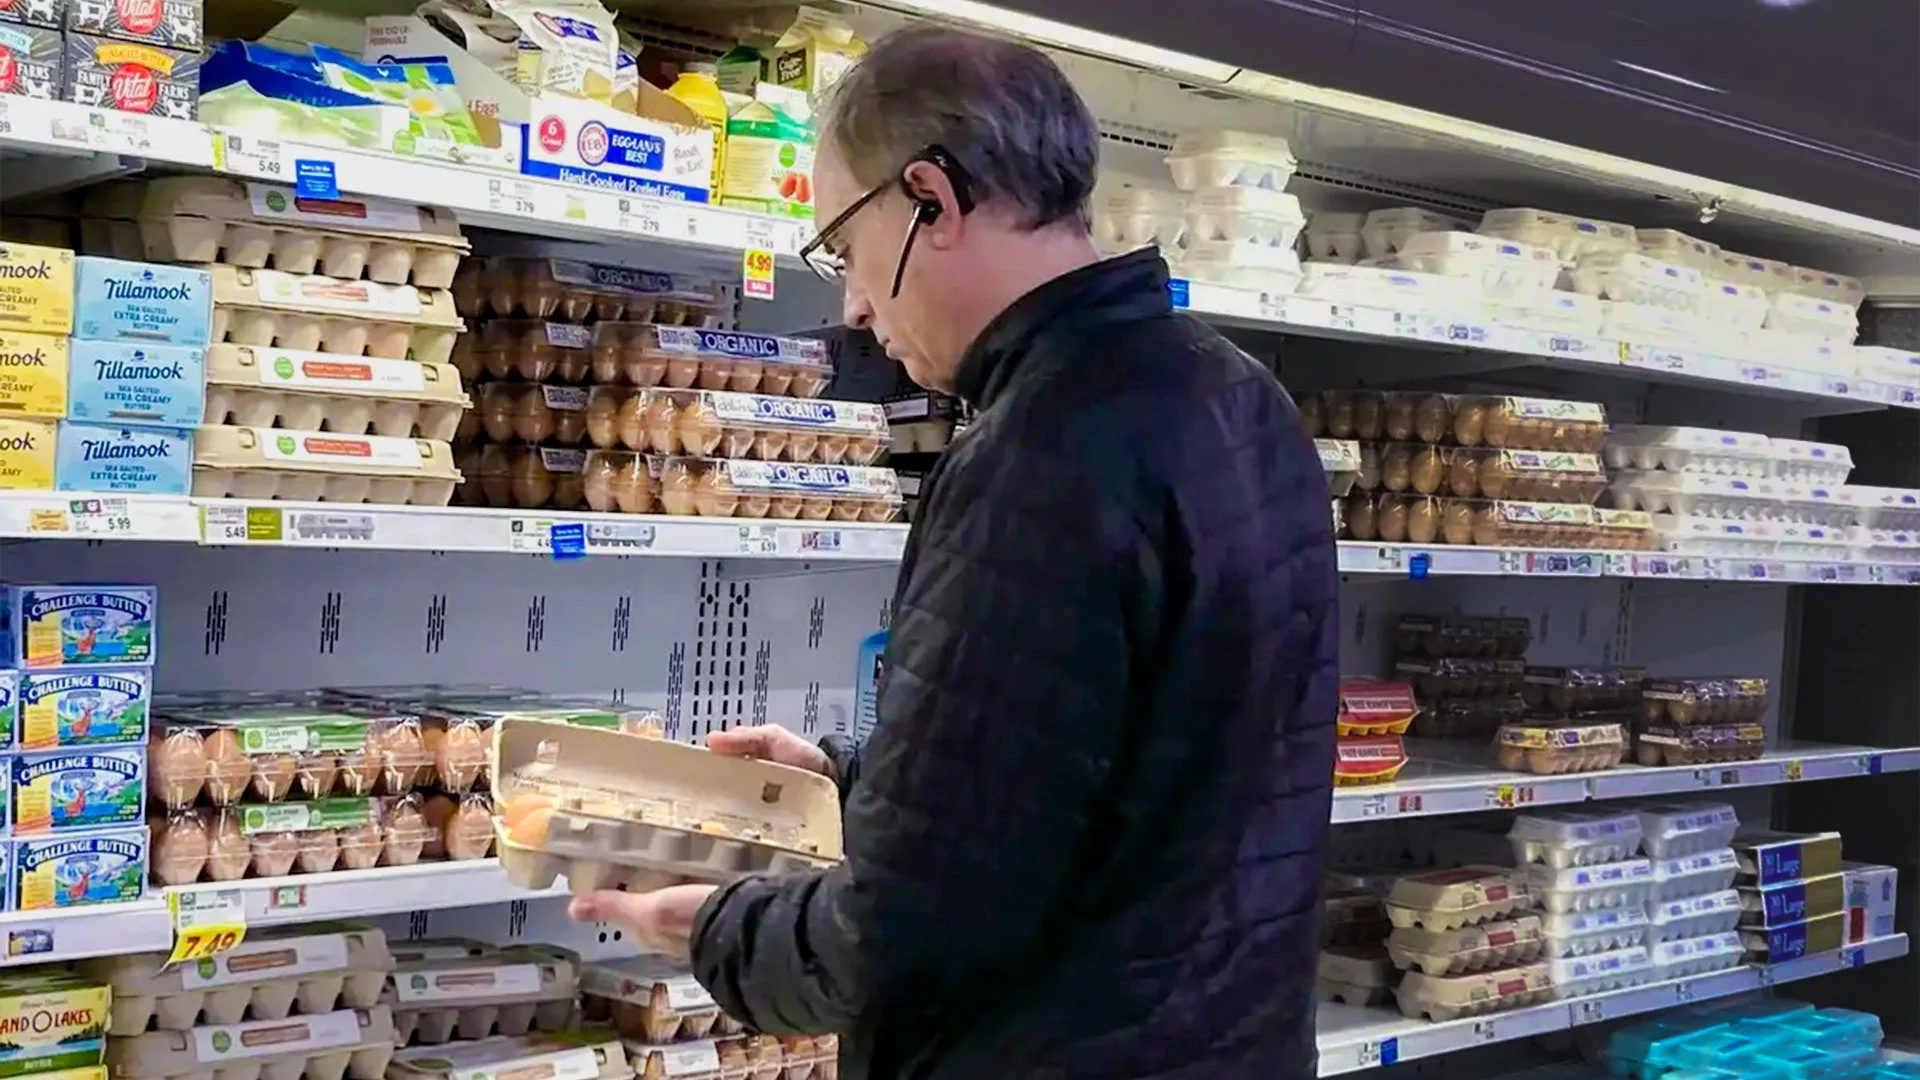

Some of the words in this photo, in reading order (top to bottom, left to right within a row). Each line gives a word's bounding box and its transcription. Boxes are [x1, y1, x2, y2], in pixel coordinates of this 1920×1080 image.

[164, 2, 193, 18] FARMS
[17, 63, 49, 81] FARMS
[114, 74, 149, 98] Vital
[158, 84, 190, 100] FARMS
[548, 122, 557, 135] 6
[625, 149, 648, 164] BEST
[559, 168, 627, 189] Hard-Cooked
[628, 180, 661, 197] Peeled
[663, 185, 686, 201] Eggs
[746, 255, 773, 274] 4.99
[598, 268, 668, 289] ORGANIC
[104, 278, 192, 300] Tillamook
[113, 311, 141, 321] EXTRA
[143, 313, 180, 325] CREAMY
[142, 305, 167, 314] SALTED
[132, 322, 160, 331] BUTTER
[704, 336, 776, 355] ORGANIC
[94, 359, 184, 381] Tillamook
[104, 391, 133, 401] EXTRA
[134, 393, 172, 404] CREAMY
[133, 386, 160, 394] SALTED
[124, 402, 152, 411] BUTTER
[761, 400, 832, 420] ORGANIC
[81, 439, 171, 461] Tillamook
[90, 471, 119, 480] EXTRA
[120, 473, 158, 482] CREAMY
[119, 465, 146, 473] SALTED
[775, 466, 848, 484] ORGANIC
[109, 481, 137, 489] BUTTER
[108, 517, 131, 530] 5.99
[225, 526, 245, 539] 5.49
[31, 594, 98, 617] CHALLENGE
[102, 594, 144, 615] BUTTER
[28, 675, 95, 698] CHALLENGE
[98, 676, 138, 698] BUTTER
[20, 757, 88, 781] CHALLENGE
[92, 757, 134, 778] BUTTER
[26, 840, 93, 866] CHALLENGE
[96, 840, 137, 860] BUTTER
[182, 931, 237, 958] 7.49
[32, 1010, 53, 1033] O
[55, 1008, 93, 1028] LAKES
